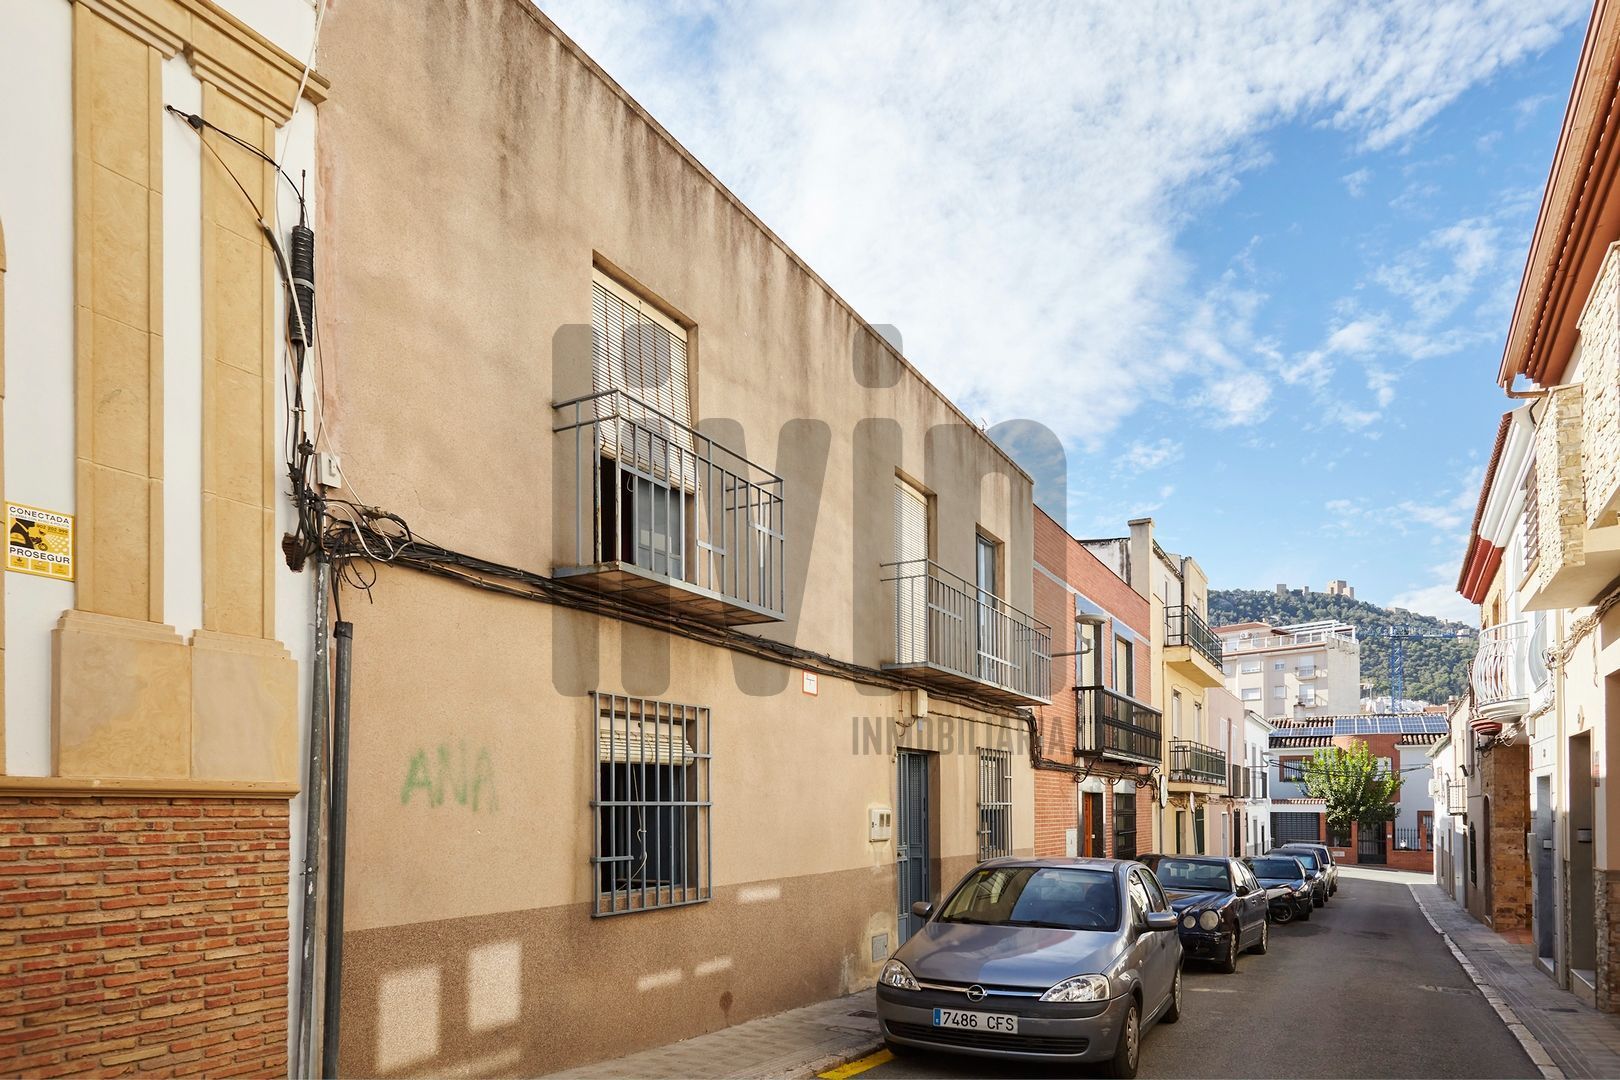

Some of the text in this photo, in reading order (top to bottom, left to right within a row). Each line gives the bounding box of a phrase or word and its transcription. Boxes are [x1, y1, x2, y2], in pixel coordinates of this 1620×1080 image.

[9, 506, 70, 525] CONECTADA
[9, 546, 70, 564] PROSEGUR
[943, 1011, 1014, 1032] 7486 CFS
